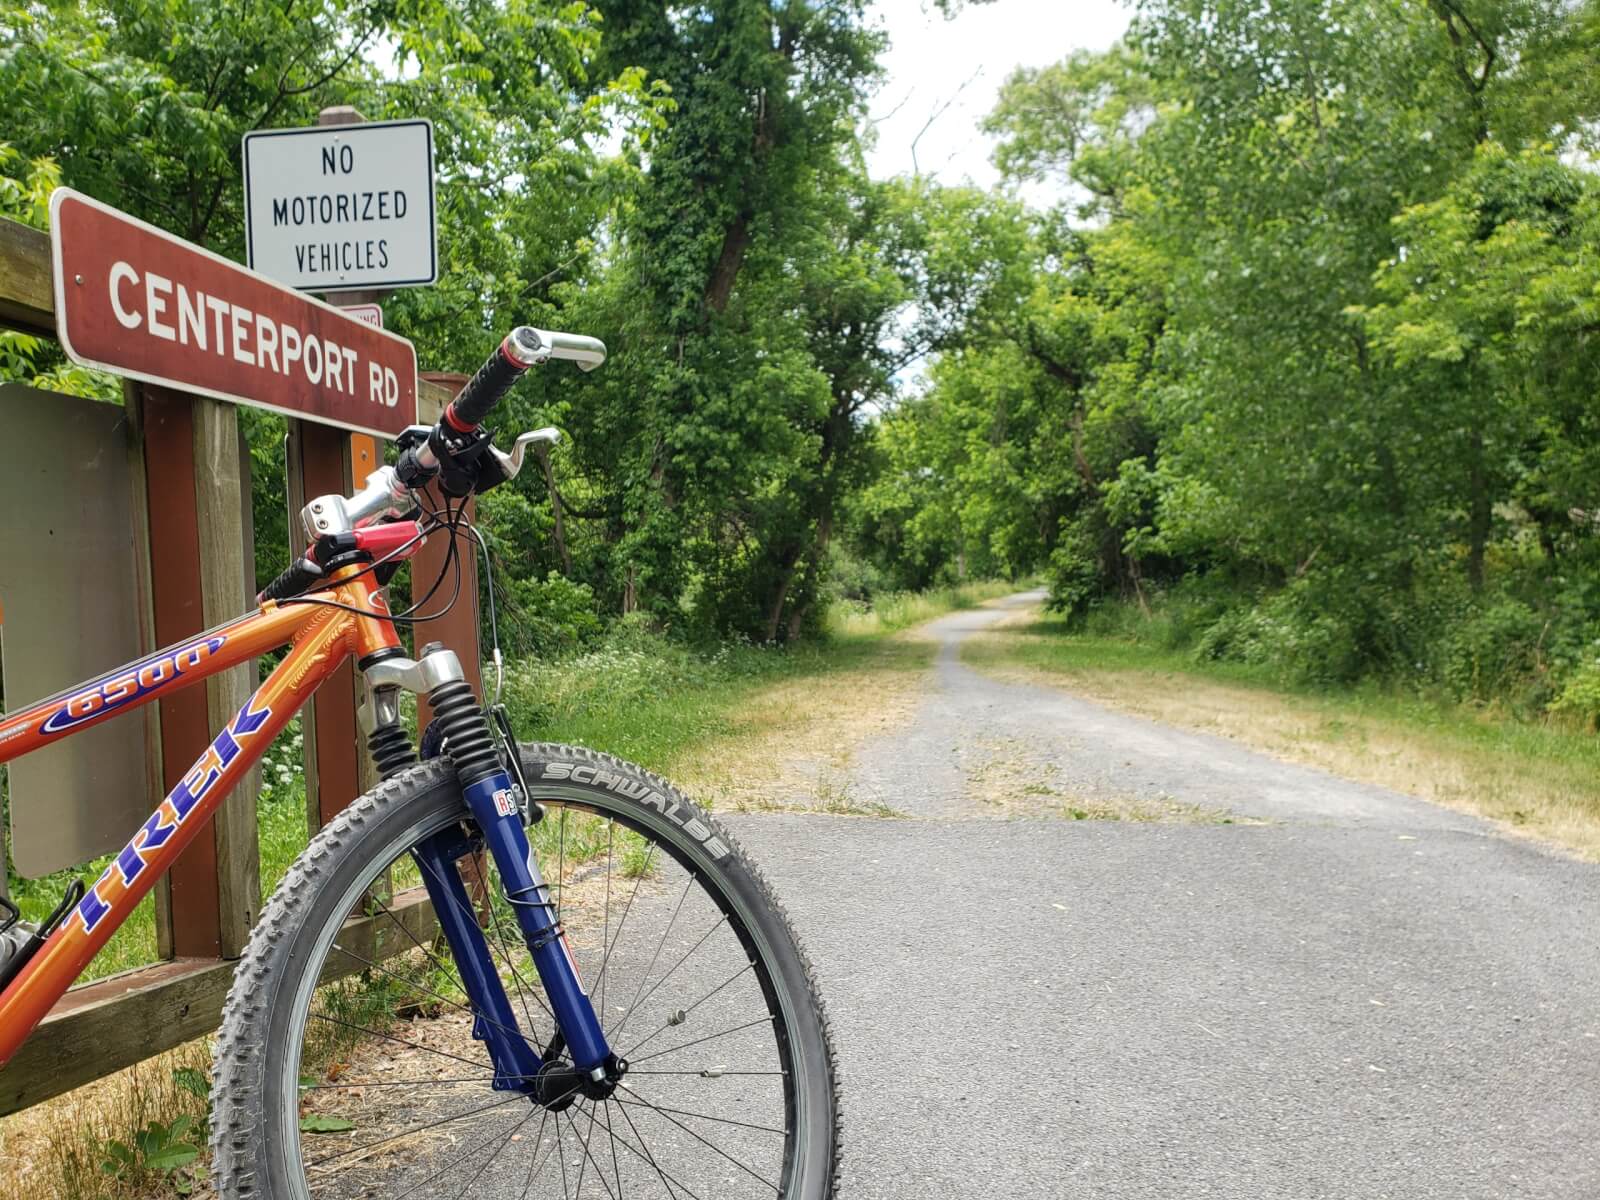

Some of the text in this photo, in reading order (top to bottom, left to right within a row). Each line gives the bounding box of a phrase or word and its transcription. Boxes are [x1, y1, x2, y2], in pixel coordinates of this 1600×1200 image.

[322, 145, 354, 175] NO
[273, 190, 408, 226] MOTORIZED
[295, 239, 389, 273] VEHICLES
[108, 261, 399, 408] CENTERPORT RD
[67, 642, 211, 718] 6500
[61, 691, 272, 935] TREK
[541, 762, 731, 861] SCHWALBE
